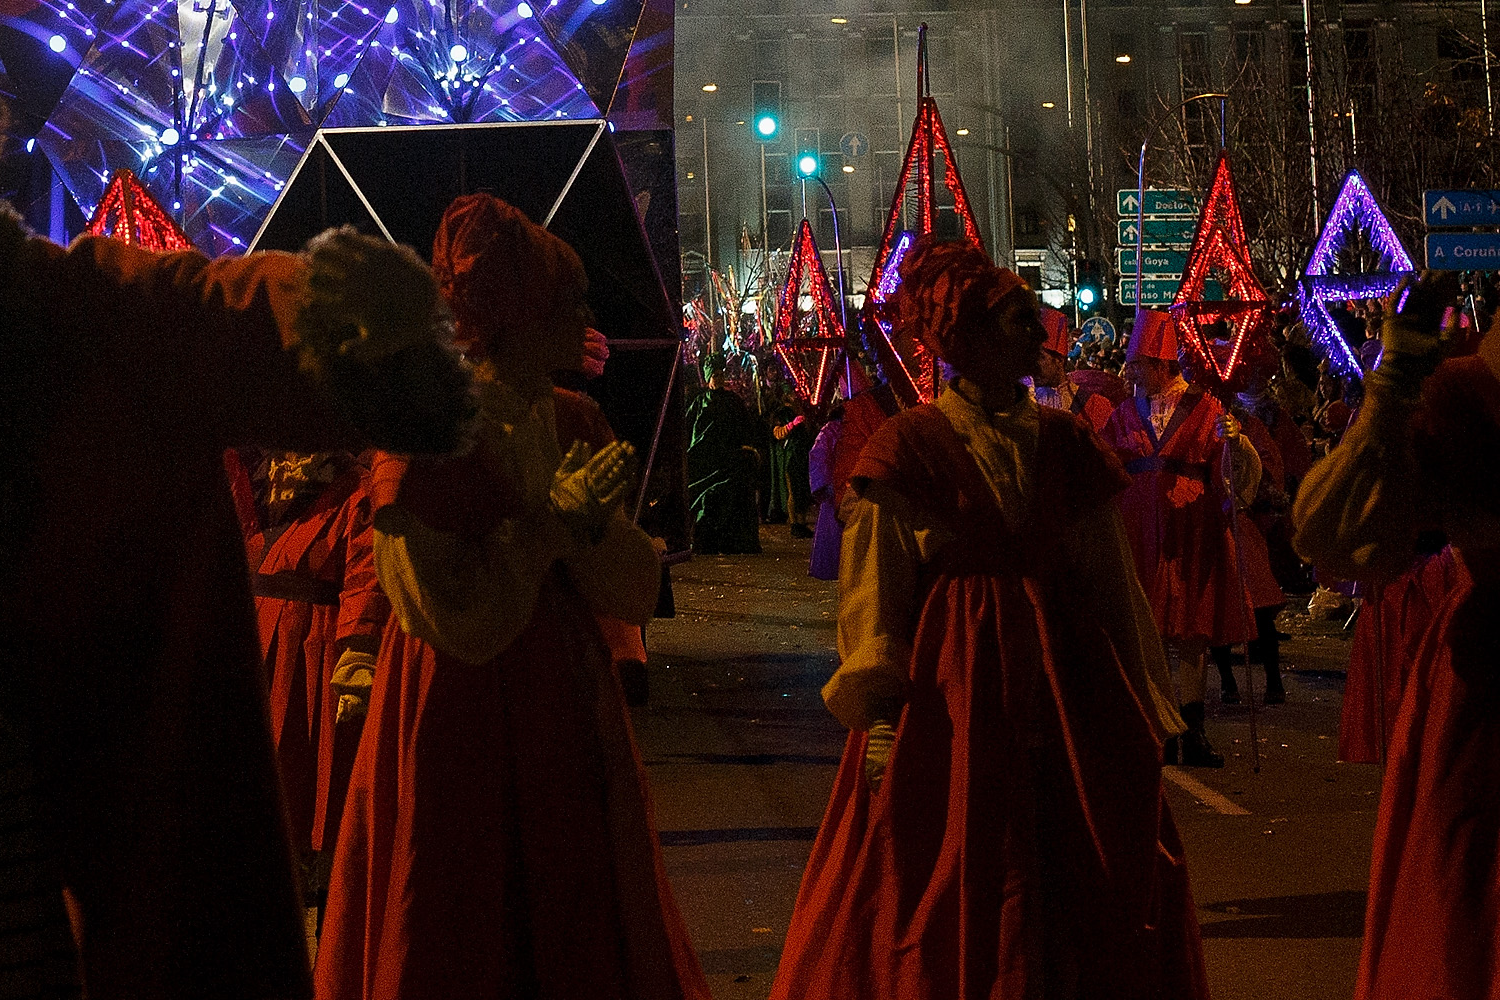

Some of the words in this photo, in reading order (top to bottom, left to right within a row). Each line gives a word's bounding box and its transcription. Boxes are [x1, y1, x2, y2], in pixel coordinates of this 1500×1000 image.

[1434, 246, 1445, 258] A
[1144, 257, 1169, 267] Goya
[1125, 291, 1158, 299] Alnso
